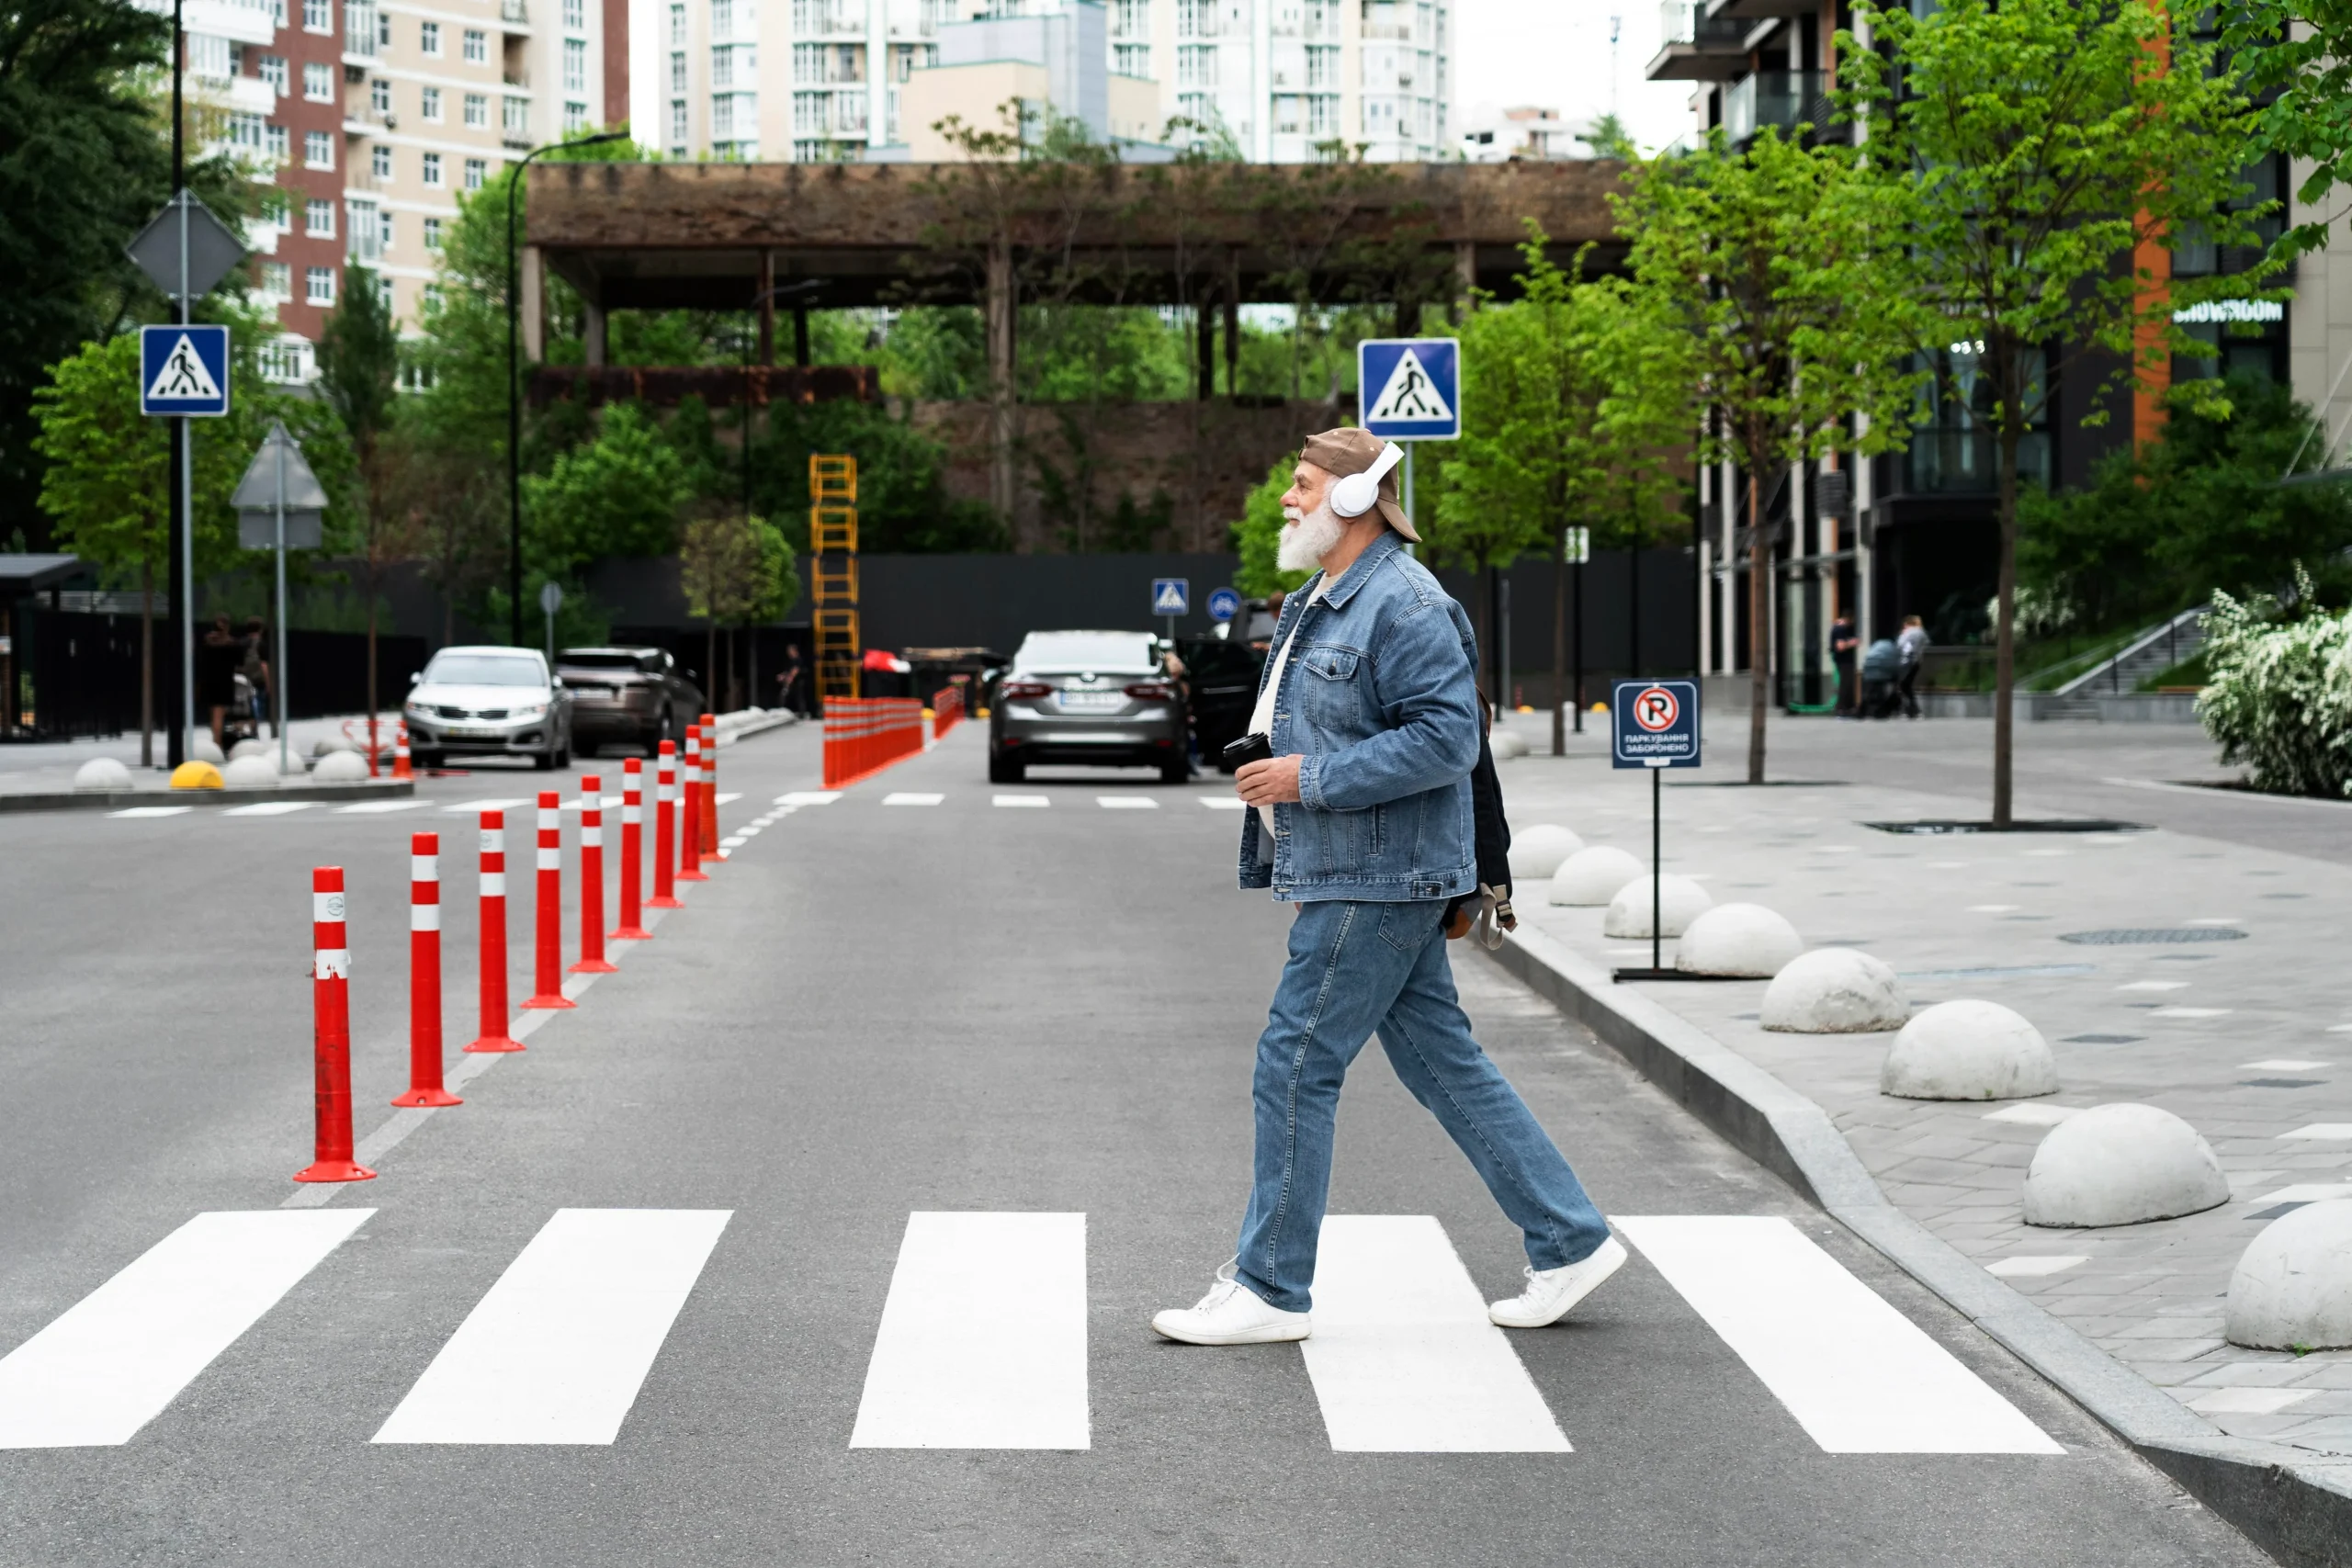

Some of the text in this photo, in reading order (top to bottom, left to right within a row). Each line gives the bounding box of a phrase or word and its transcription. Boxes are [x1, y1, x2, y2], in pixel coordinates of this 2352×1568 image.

[1648, 697, 1668, 721] P
[1624, 734, 1689, 743] ПАРКУВАННЯ
[1625, 743, 1689, 753] ЗАБОРОНЕНО
